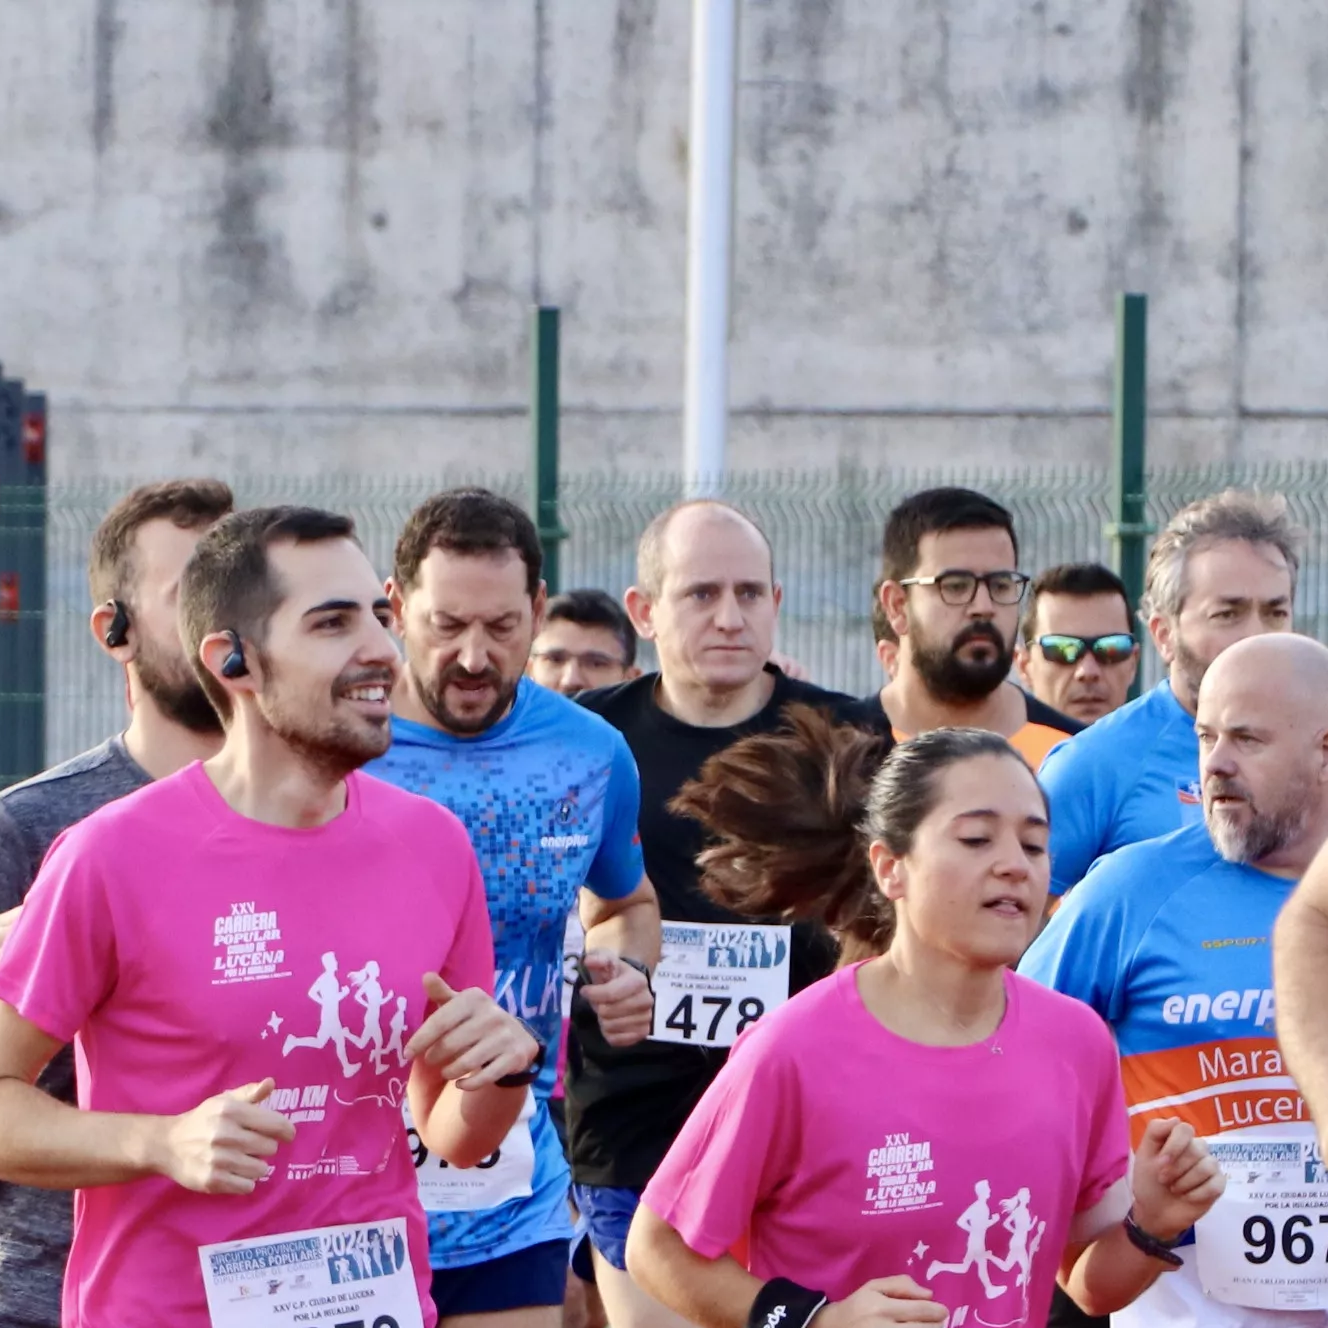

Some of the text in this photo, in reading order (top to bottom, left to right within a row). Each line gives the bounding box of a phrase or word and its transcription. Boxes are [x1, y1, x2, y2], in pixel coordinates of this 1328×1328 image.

[540, 835, 588, 849] enerplus
[231, 901, 255, 915] XXV
[215, 911, 277, 935] CARRERA
[213, 929, 281, 946] POPULAR
[708, 929, 749, 947] 2024
[213, 950, 285, 970] LUCENA
[1163, 988, 1275, 1027] enerp
[1198, 1046, 1282, 1081] Mara
[300, 1085, 329, 1107] KM
[885, 1132, 909, 1147] XXV
[868, 1141, 930, 1166] CARRERA
[866, 1160, 934, 1178] POPULAR
[865, 1180, 936, 1201] LUCENA
[210, 1248, 254, 1268] CIRCUITO
[255, 1239, 309, 1258] PROVINCIAL
[323, 1229, 369, 1257] 2024
[212, 1250, 323, 1275] CARRERAS POPULARES
[273, 1289, 375, 1313] XXV C.P. CIUDAD DE LUCENA
[293, 1312, 310, 1322] POR
[312, 1310, 322, 1319] LA
